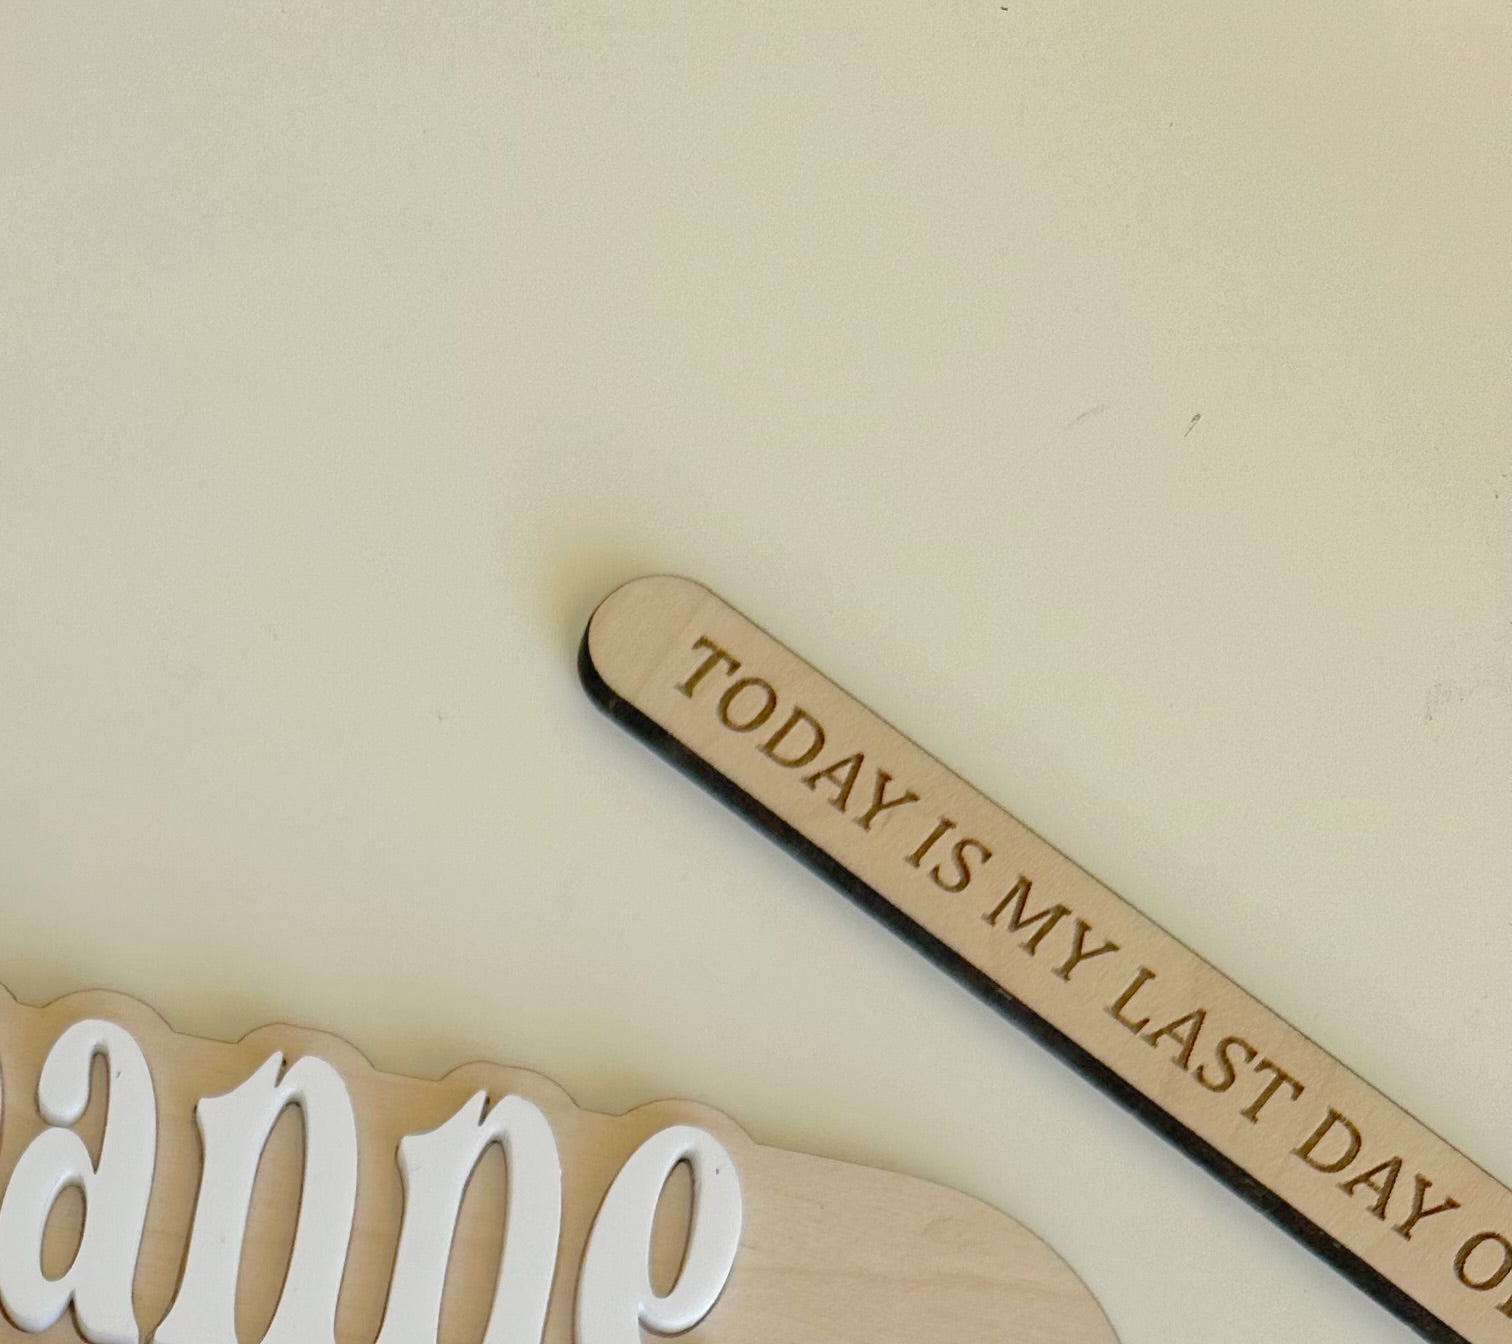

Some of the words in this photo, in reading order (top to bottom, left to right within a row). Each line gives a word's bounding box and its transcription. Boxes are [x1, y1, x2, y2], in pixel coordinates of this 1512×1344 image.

[673, 636, 919, 832] TODAY
[906, 817, 992, 895] IS
[982, 876, 1119, 981] MY
[1106, 967, 1304, 1125] LAST
[1291, 1109, 1461, 1241] DAY
[1453, 1231, 1512, 1319] O
